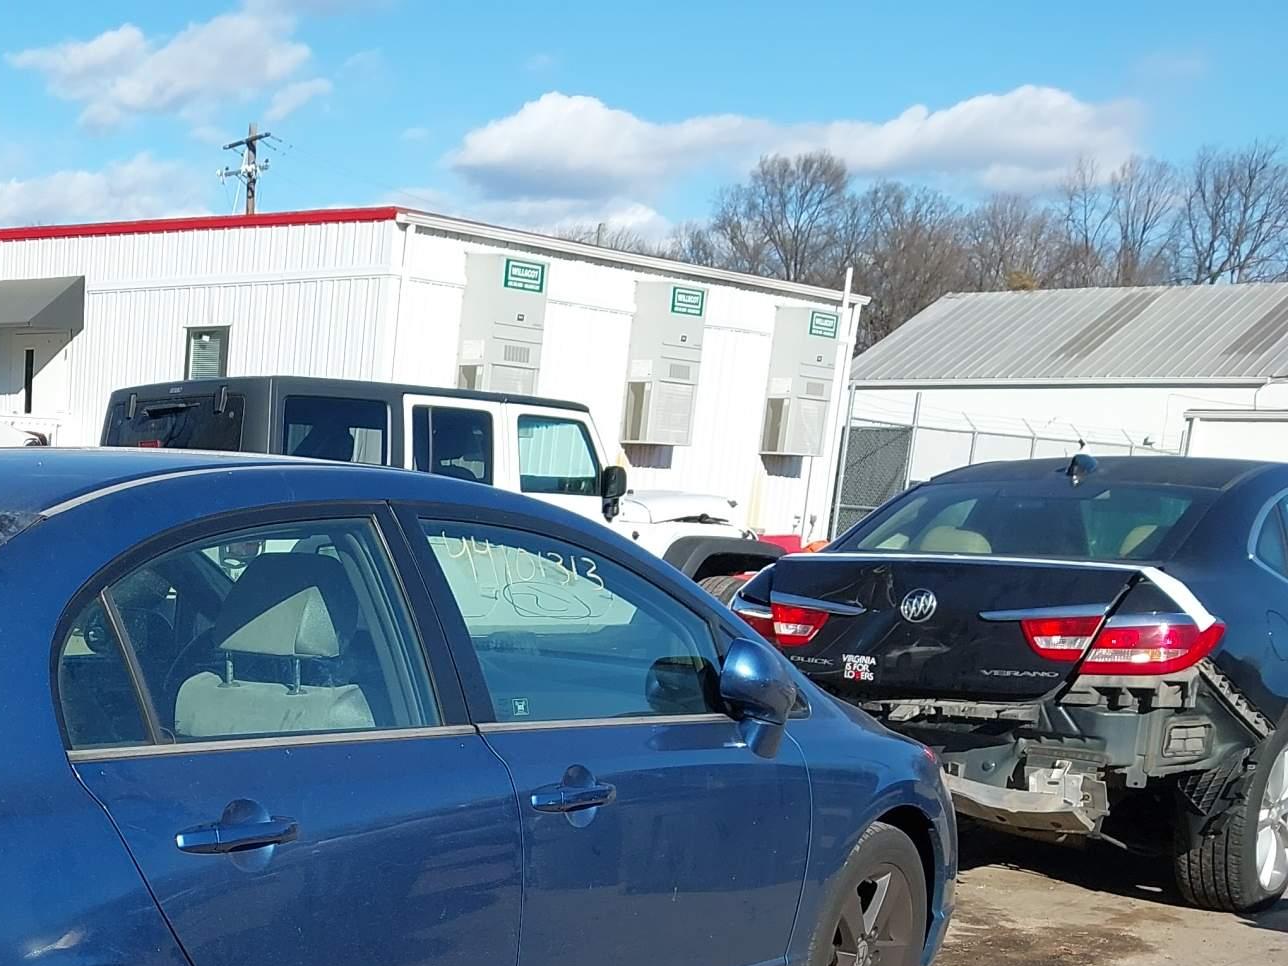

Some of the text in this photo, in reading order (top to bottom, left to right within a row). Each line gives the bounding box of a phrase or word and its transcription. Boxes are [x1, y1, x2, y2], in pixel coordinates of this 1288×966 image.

[441, 530, 604, 592] 44101313
[790, 655, 834, 665] BUICK
[842, 653, 877, 665] VIRGINIA
[845, 662, 870, 672] IS FOR
[979, 669, 1059, 678] VERANO
